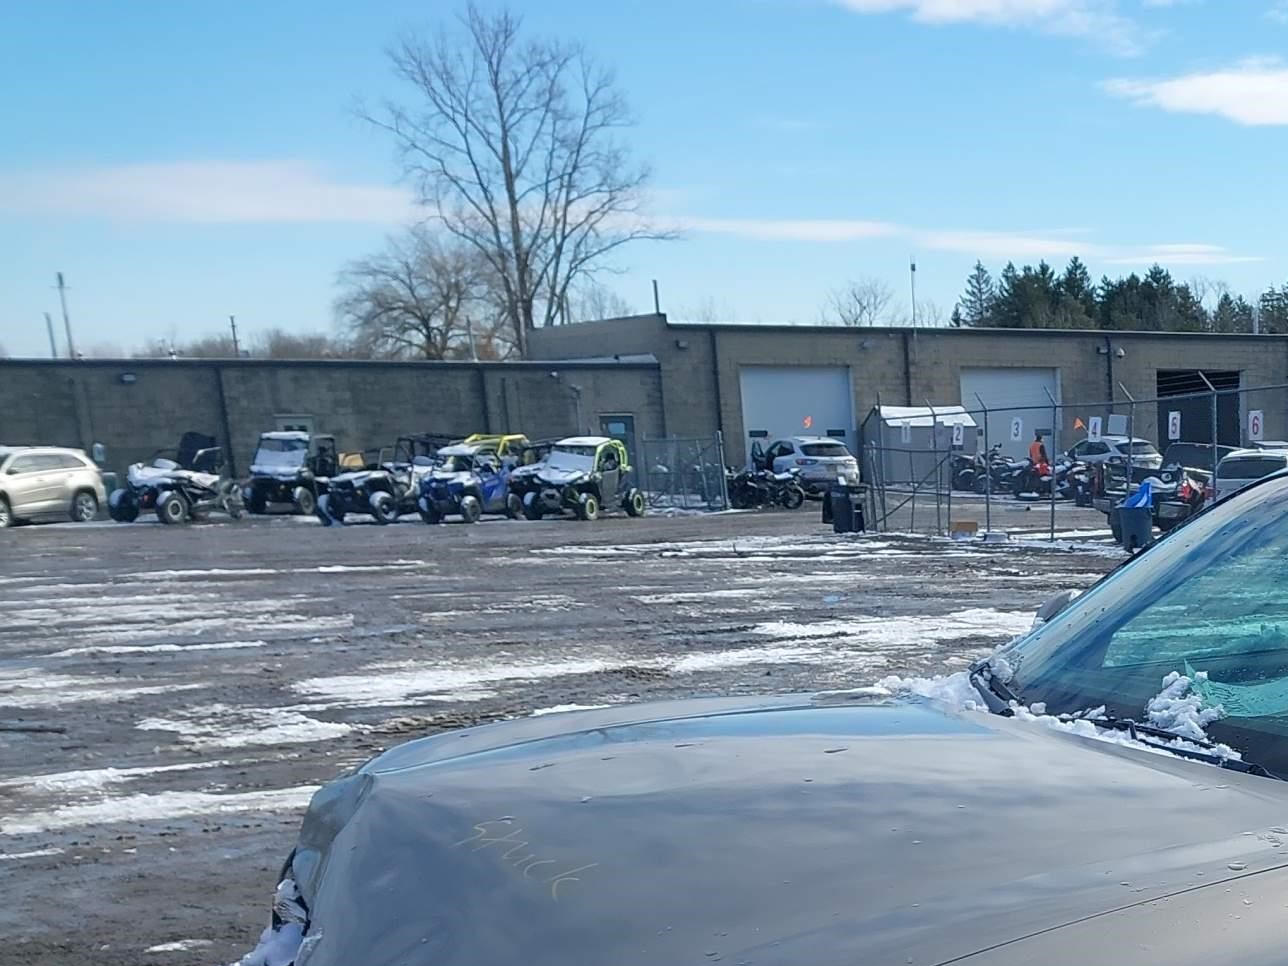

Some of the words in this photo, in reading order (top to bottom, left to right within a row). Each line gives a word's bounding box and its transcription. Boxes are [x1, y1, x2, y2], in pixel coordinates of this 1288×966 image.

[954, 426, 961, 441] 2
[1013, 421, 1020, 437] 3
[1091, 421, 1098, 438] 4
[1171, 416, 1178, 434] 5
[1252, 415, 1260, 435] 6
